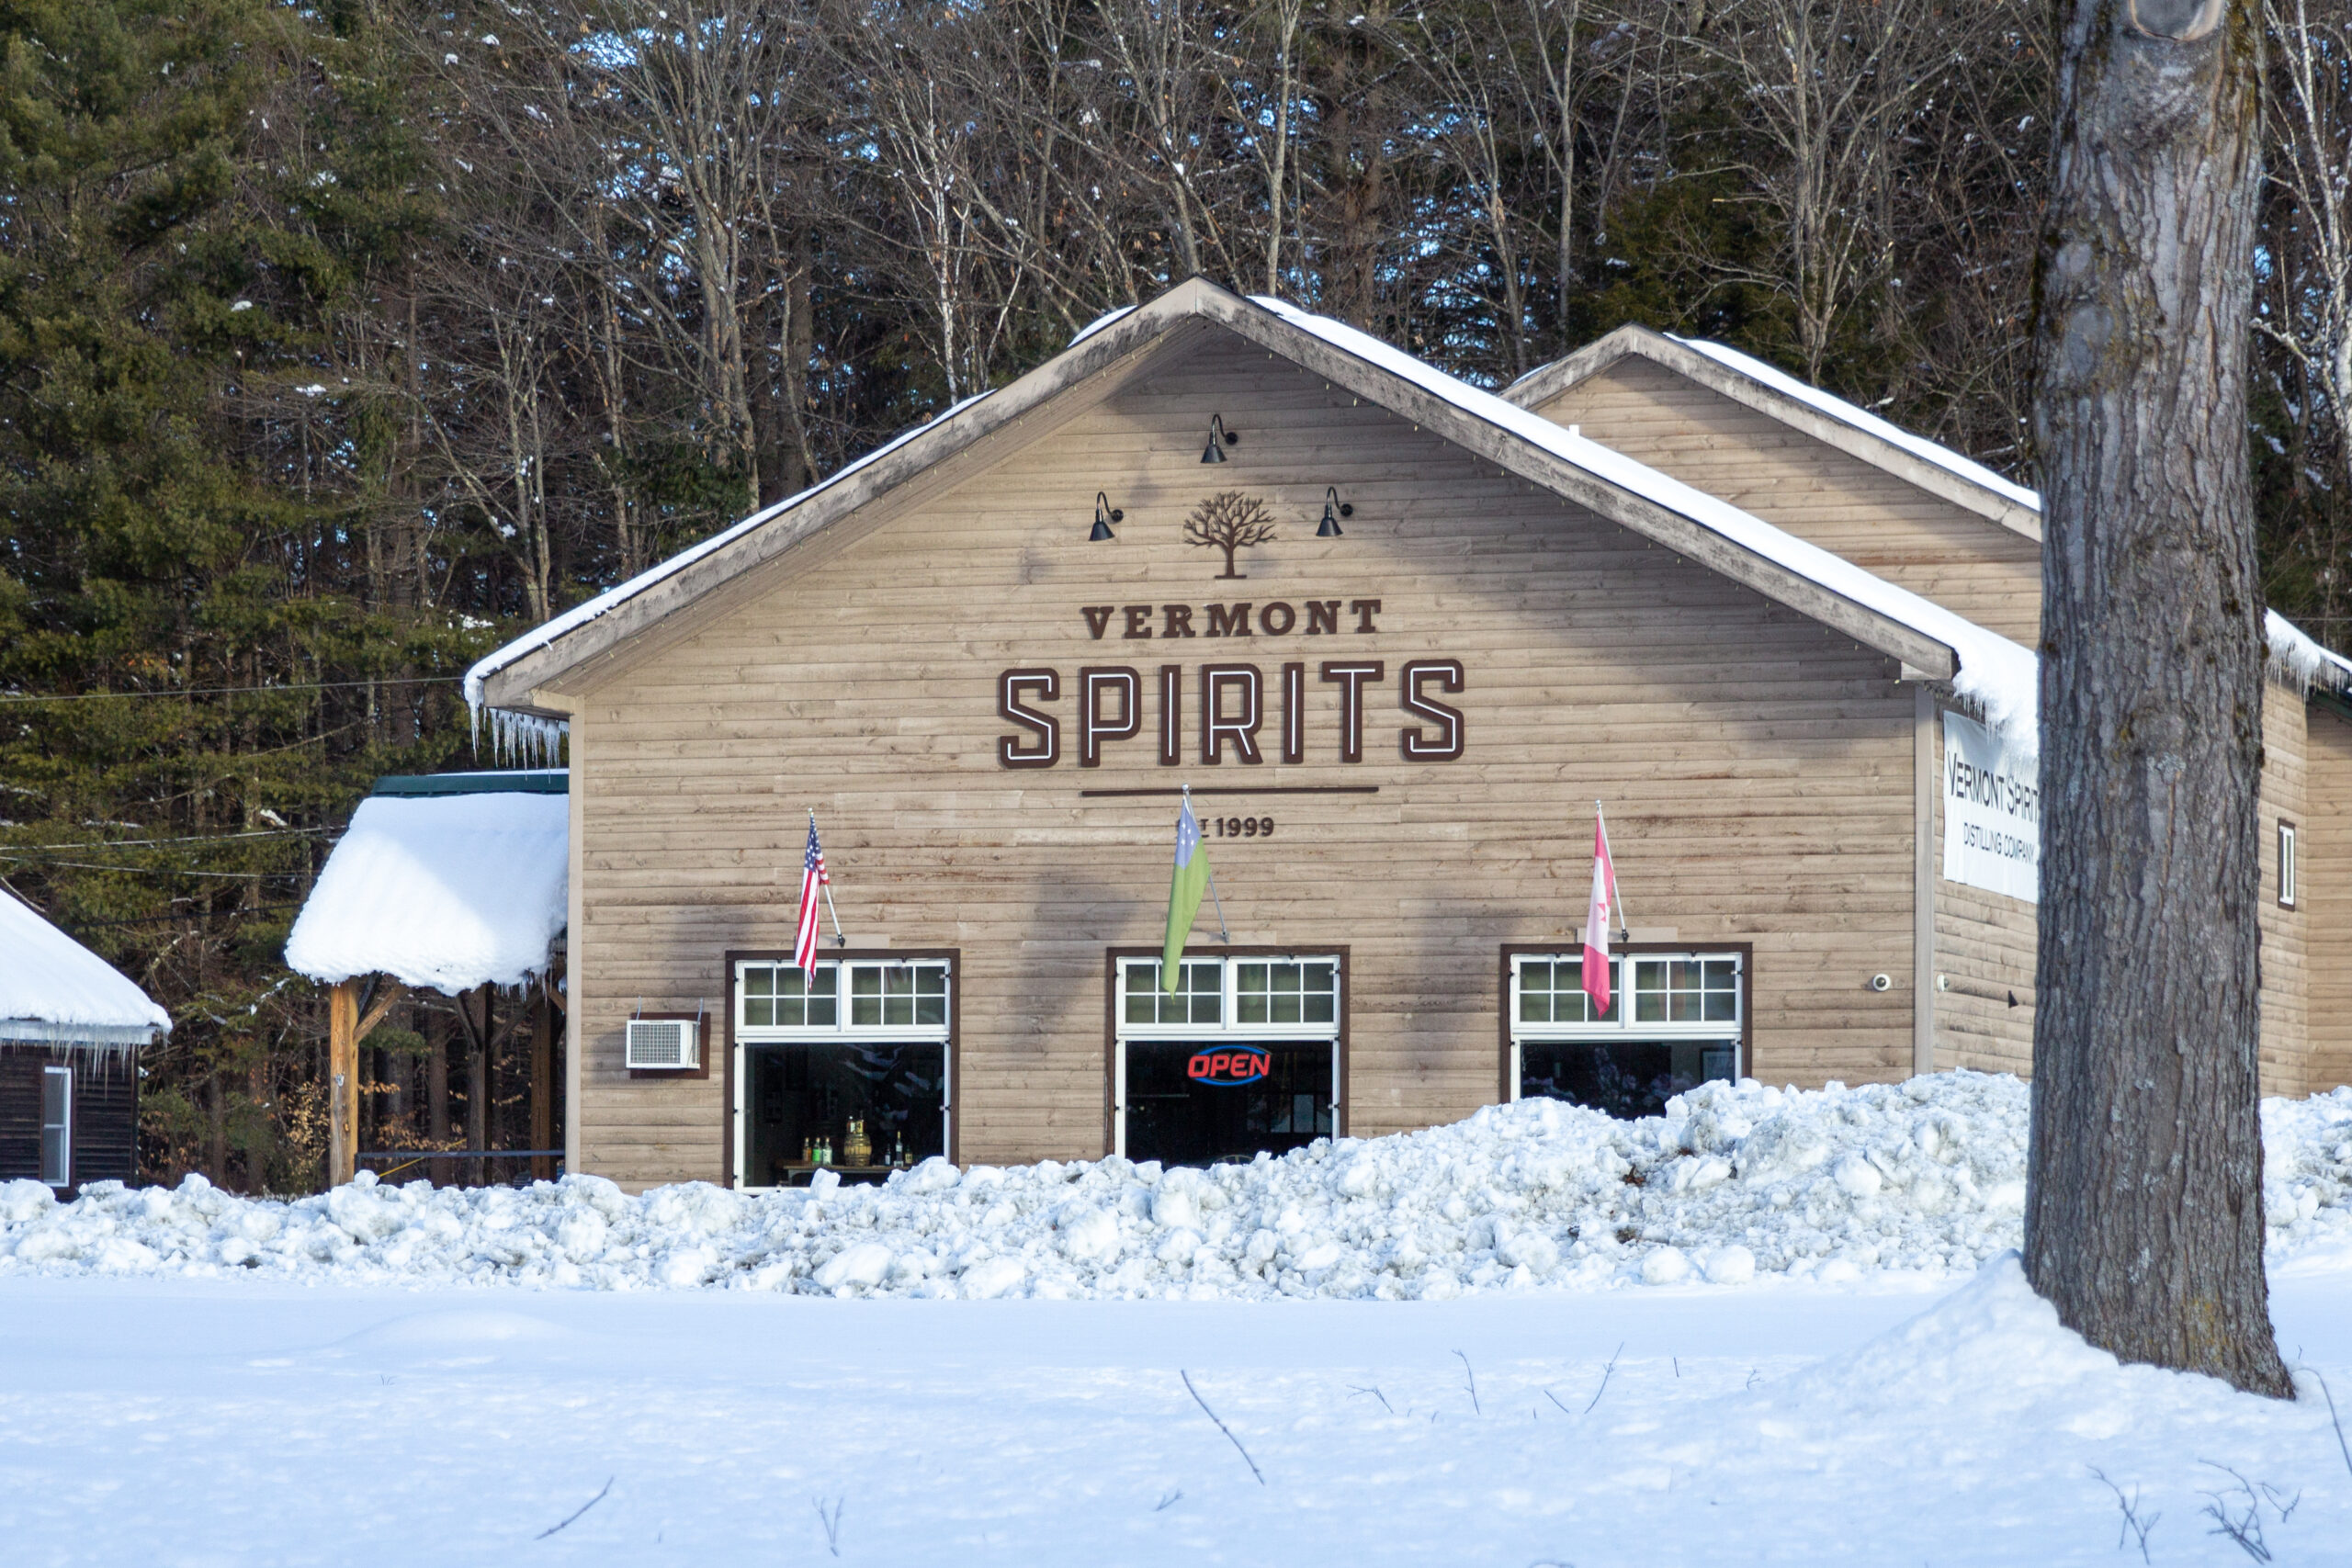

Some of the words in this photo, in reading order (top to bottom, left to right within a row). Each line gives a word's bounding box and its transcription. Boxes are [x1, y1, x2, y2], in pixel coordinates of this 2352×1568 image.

[1082, 599, 1382, 640] VERMONT
[1001, 660, 1464, 769] SPIRITS
[1947, 750, 2005, 812] VERMONT
[2007, 773, 2039, 824] SPIRIT
[1216, 817, 1274, 838] 1999
[1963, 822, 2002, 855] DISTILLING
[2004, 834, 2035, 865] COMPANY
[1187, 1054, 1271, 1078] OPEN
